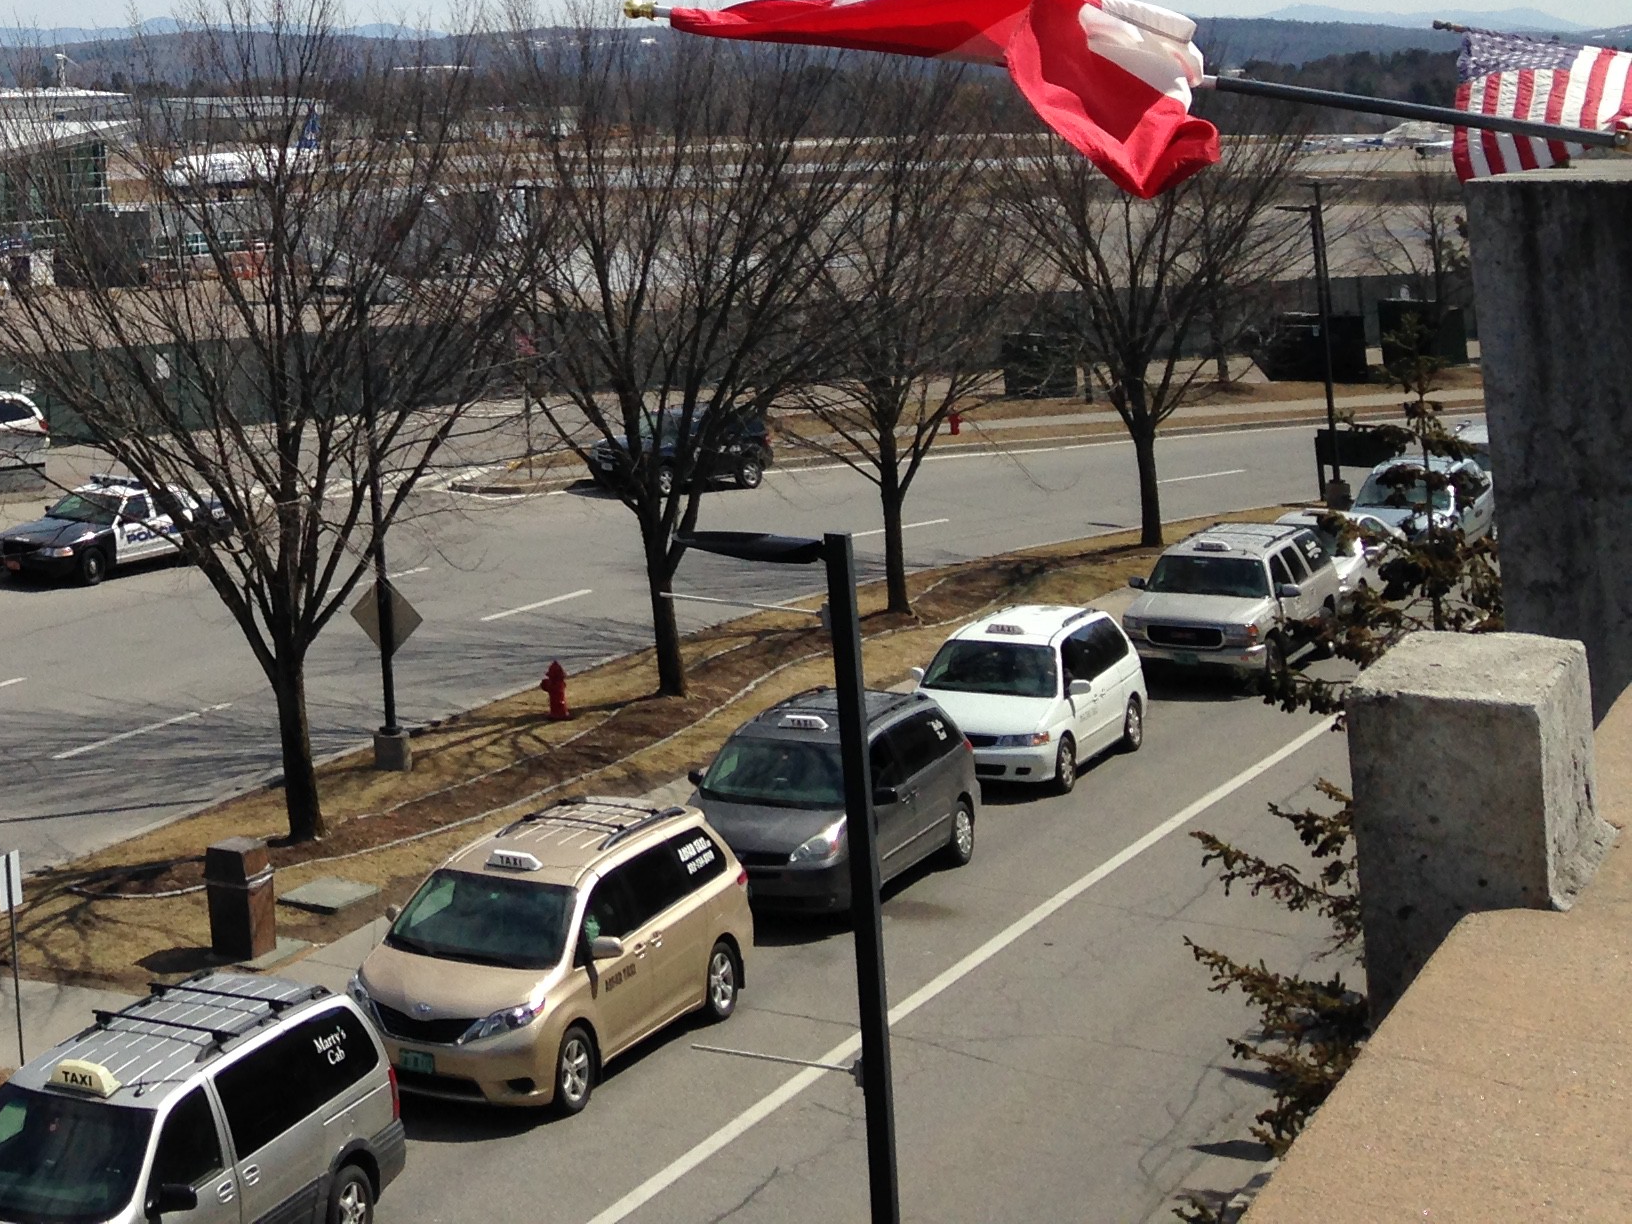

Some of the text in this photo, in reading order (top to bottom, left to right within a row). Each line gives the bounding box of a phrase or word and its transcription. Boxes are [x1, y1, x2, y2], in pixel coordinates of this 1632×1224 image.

[499, 855, 523, 868] TAXI
[313, 1025, 347, 1054] Marty's
[327, 1045, 346, 1065] Cab
[62, 1070, 93, 1087] TAXI
